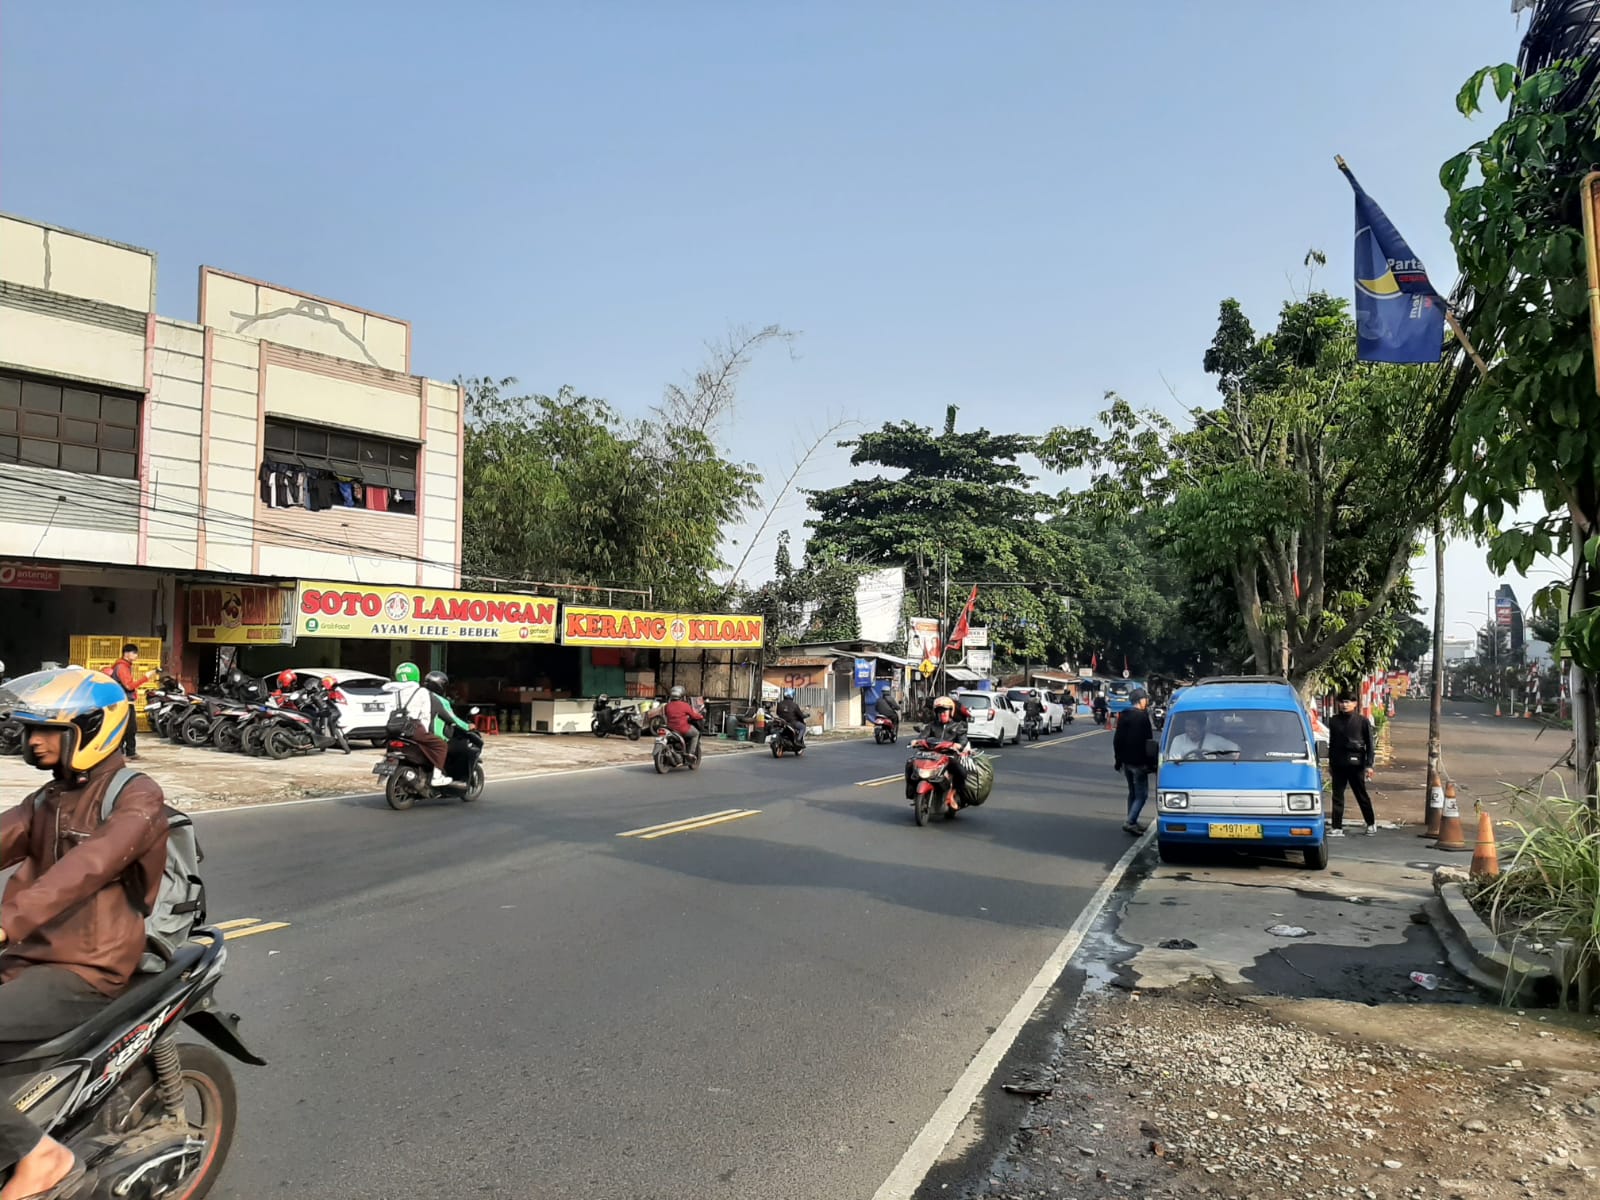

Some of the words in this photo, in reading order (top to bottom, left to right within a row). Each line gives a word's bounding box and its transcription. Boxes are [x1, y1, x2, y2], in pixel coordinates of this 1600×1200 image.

[301, 590, 382, 617] SOTO
[413, 597, 554, 624] LAMONGAN
[371, 624, 408, 635] AYAM
[419, 625, 449, 636] LELE
[459, 627, 499, 638] BEBEK
[566, 613, 667, 640] KERANG
[688, 619, 761, 642] KILOAN
